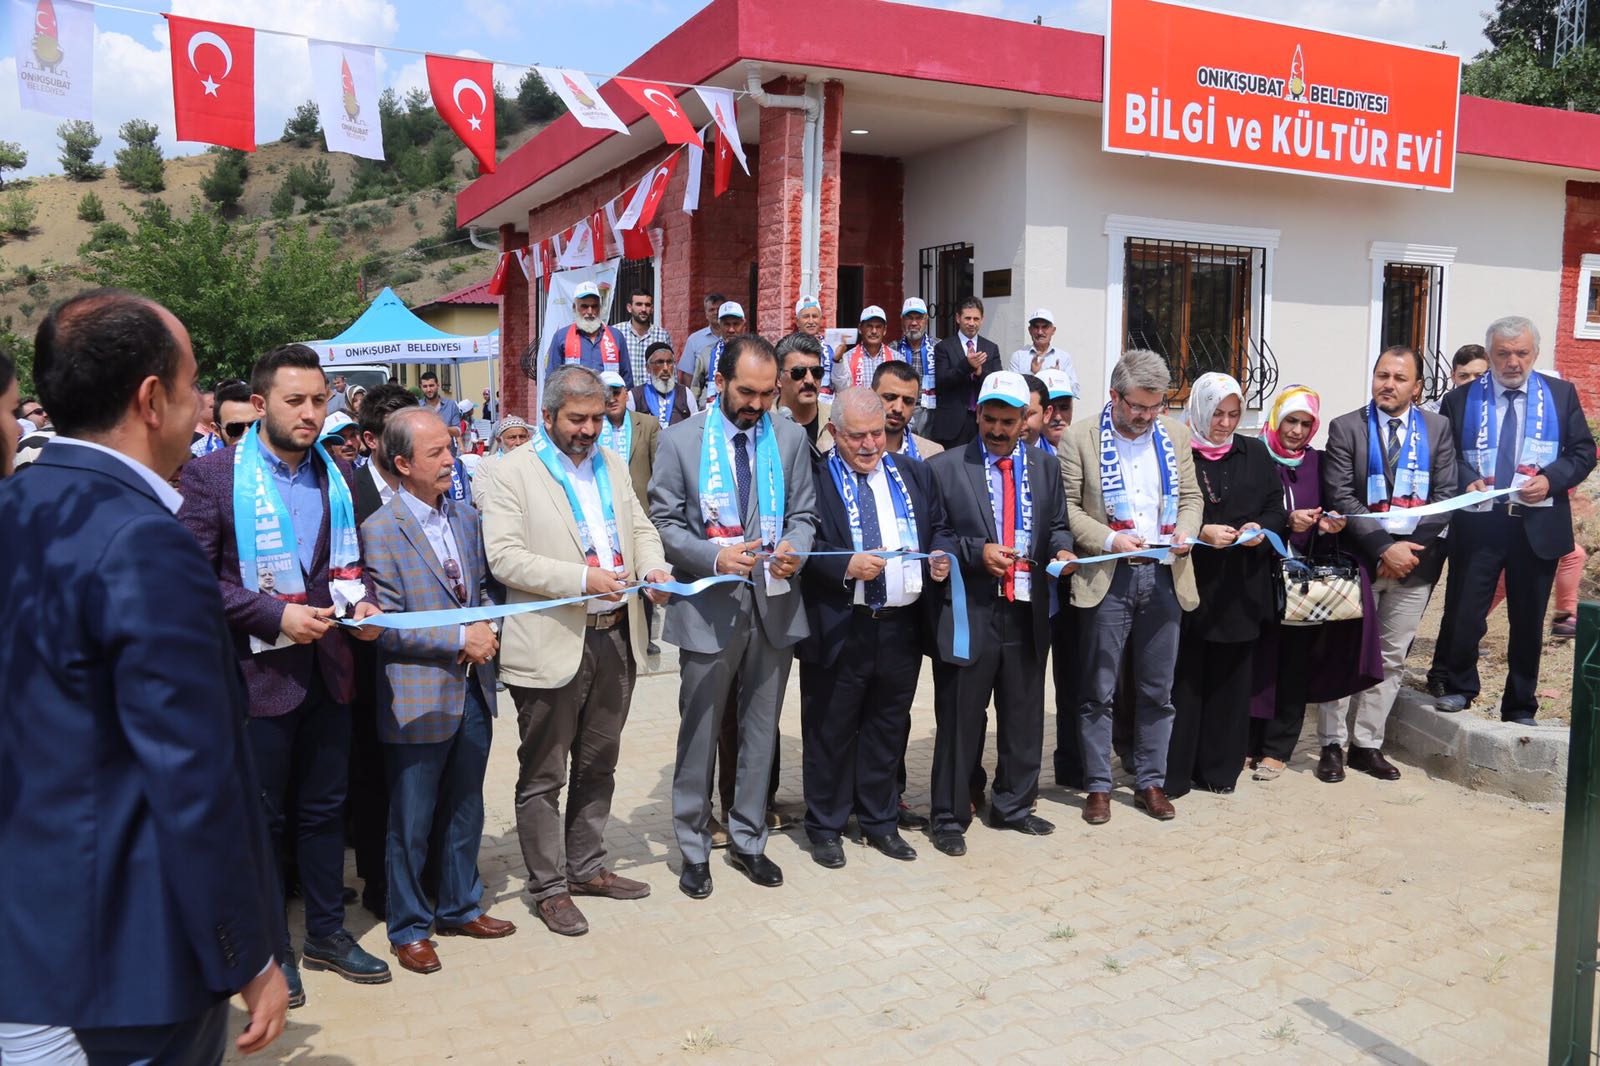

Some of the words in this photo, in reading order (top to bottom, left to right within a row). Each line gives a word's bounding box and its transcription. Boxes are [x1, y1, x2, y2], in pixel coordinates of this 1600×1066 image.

[1125, 87, 1215, 145] BİLGİ
[1226, 115, 1262, 150] ve
[1272, 109, 1387, 168] KÜLTÜR
[1396, 129, 1443, 175] EVİ
[1100, 429, 1123, 491] RECEP
